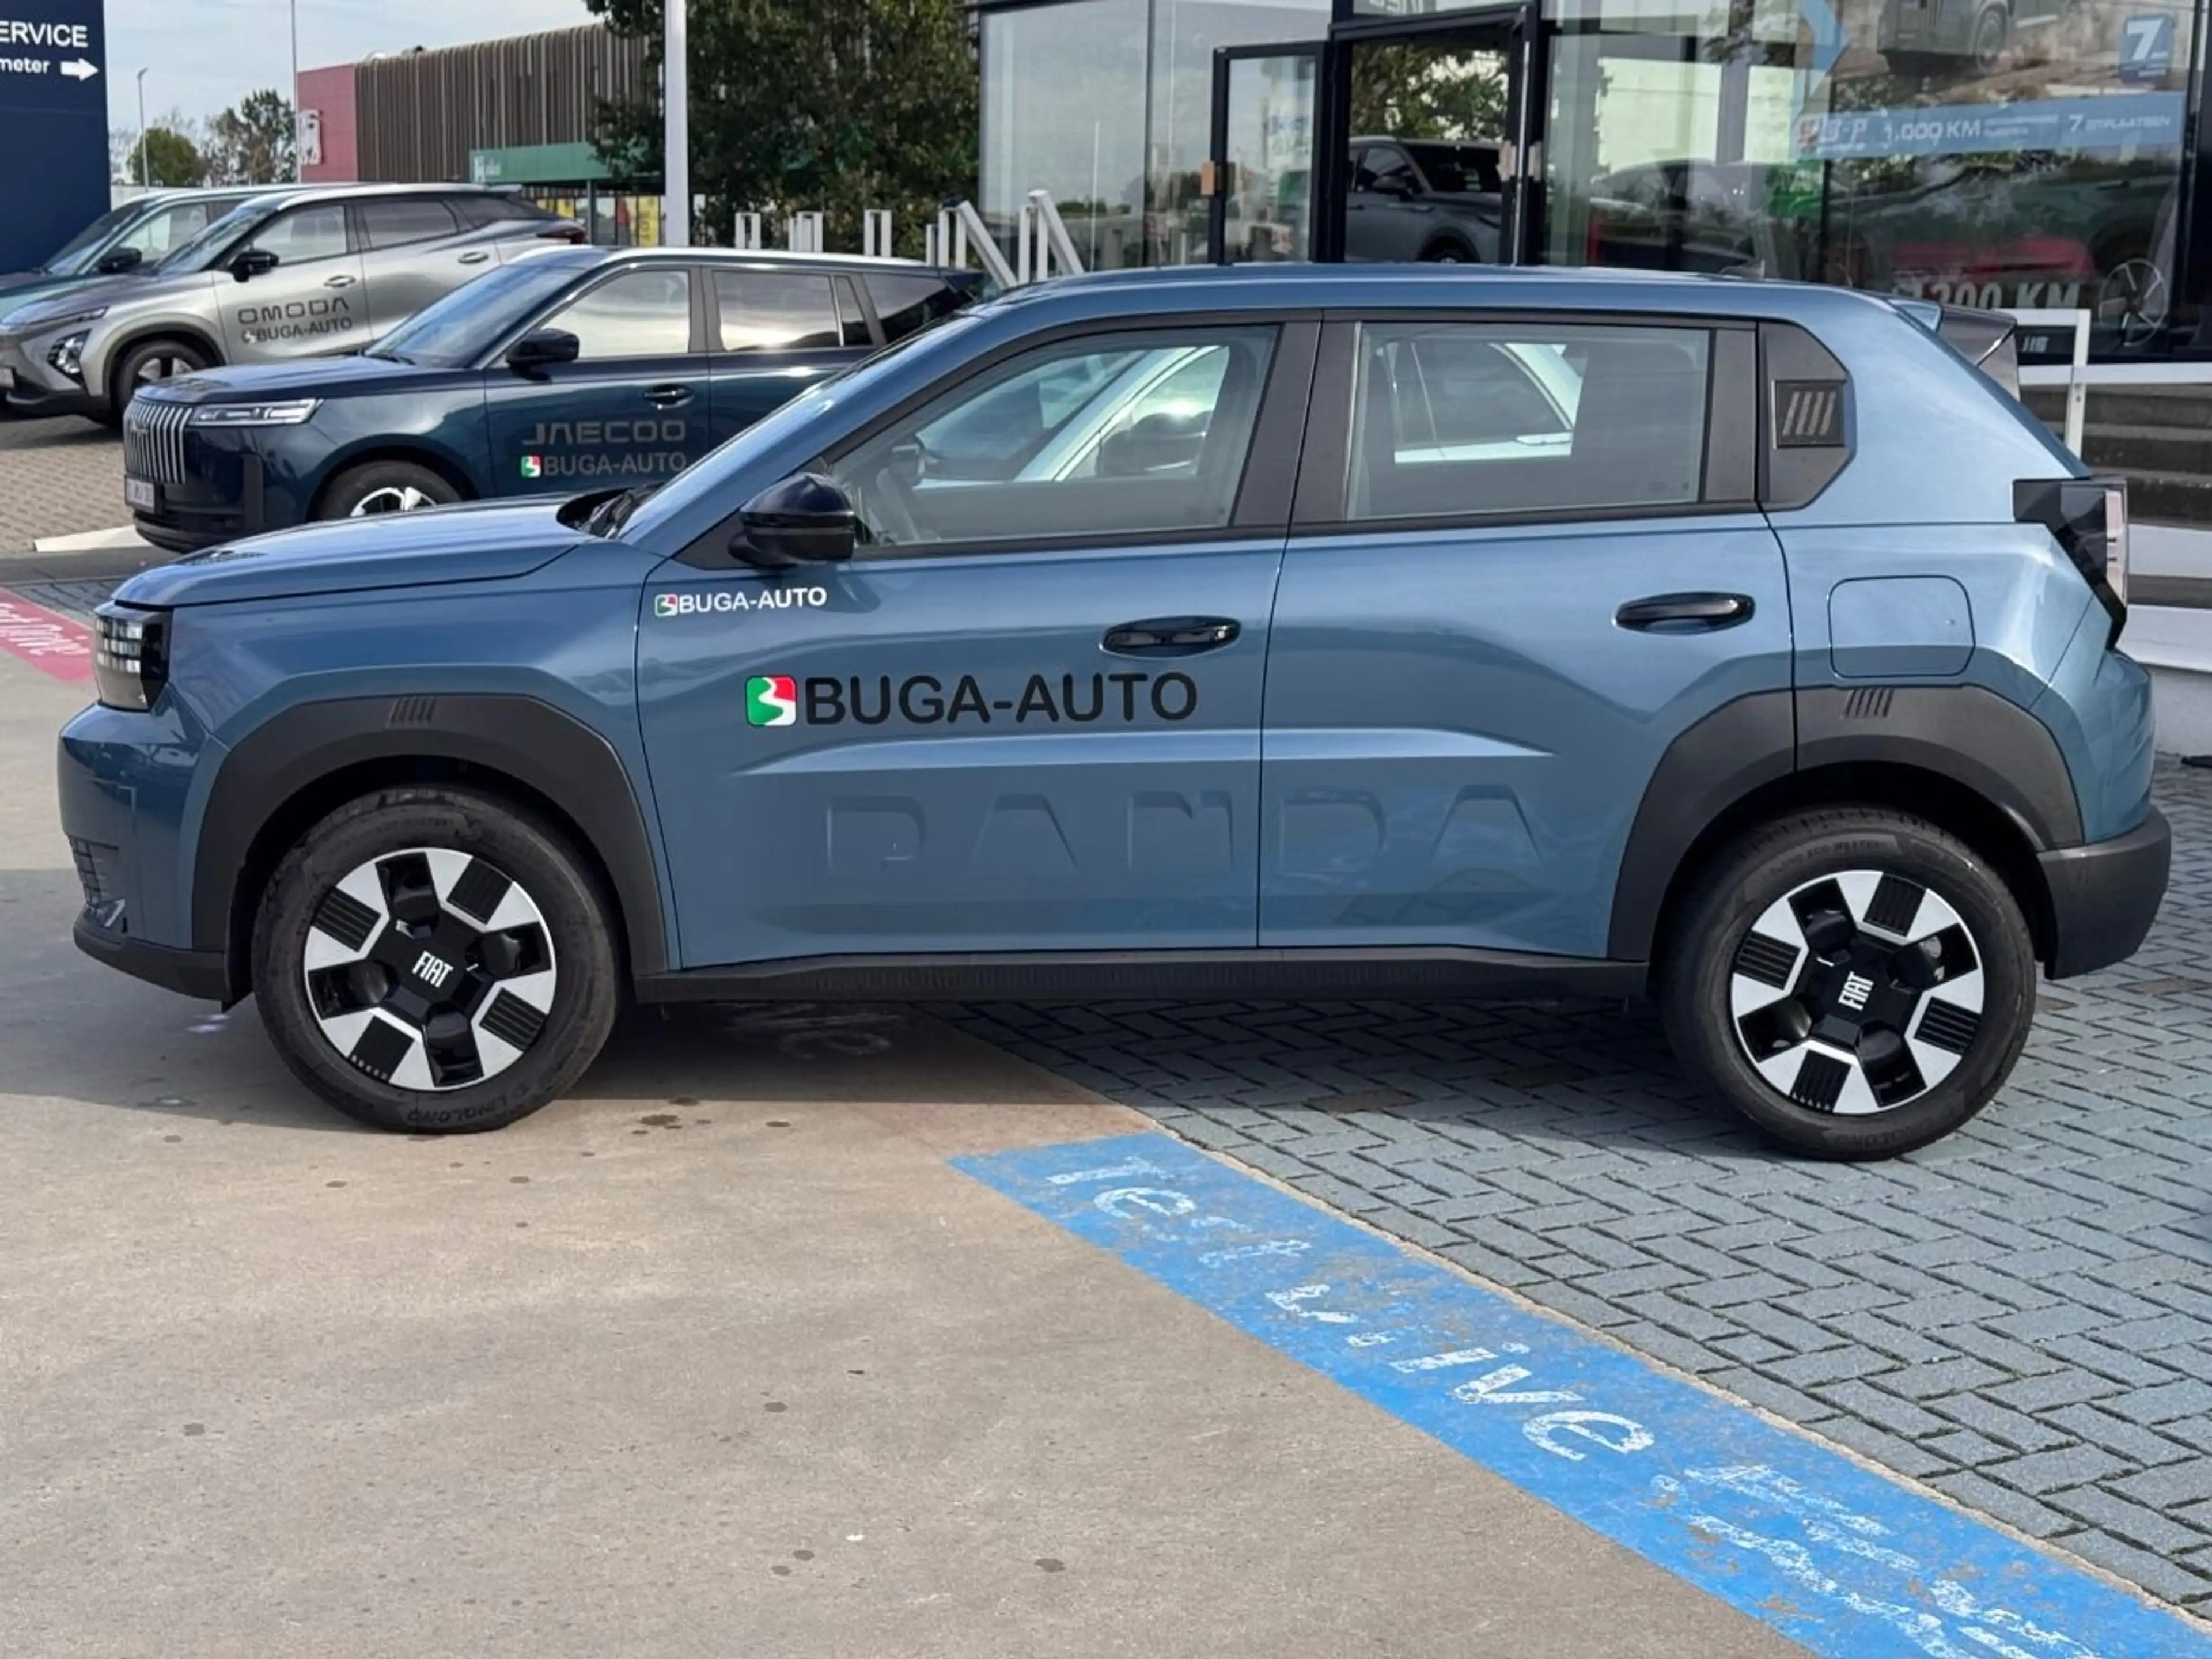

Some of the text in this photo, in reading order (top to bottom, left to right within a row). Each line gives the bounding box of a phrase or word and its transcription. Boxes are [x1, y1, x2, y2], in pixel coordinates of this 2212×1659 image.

[2127, 17, 2164, 62] 7
[1946, 118, 1982, 139] KM
[238, 297, 350, 324] OMODA
[257, 316, 353, 342] BUGA-AUTO
[521, 419, 686, 446] JAECOO
[544, 452, 687, 477] BUGA-AUTO
[679, 586, 827, 614] BUGA-AUTO
[805, 672, 1198, 725] BUGA-AUTO
[411, 950, 454, 988] FIAT
[1838, 971, 1874, 1011] FIAT
